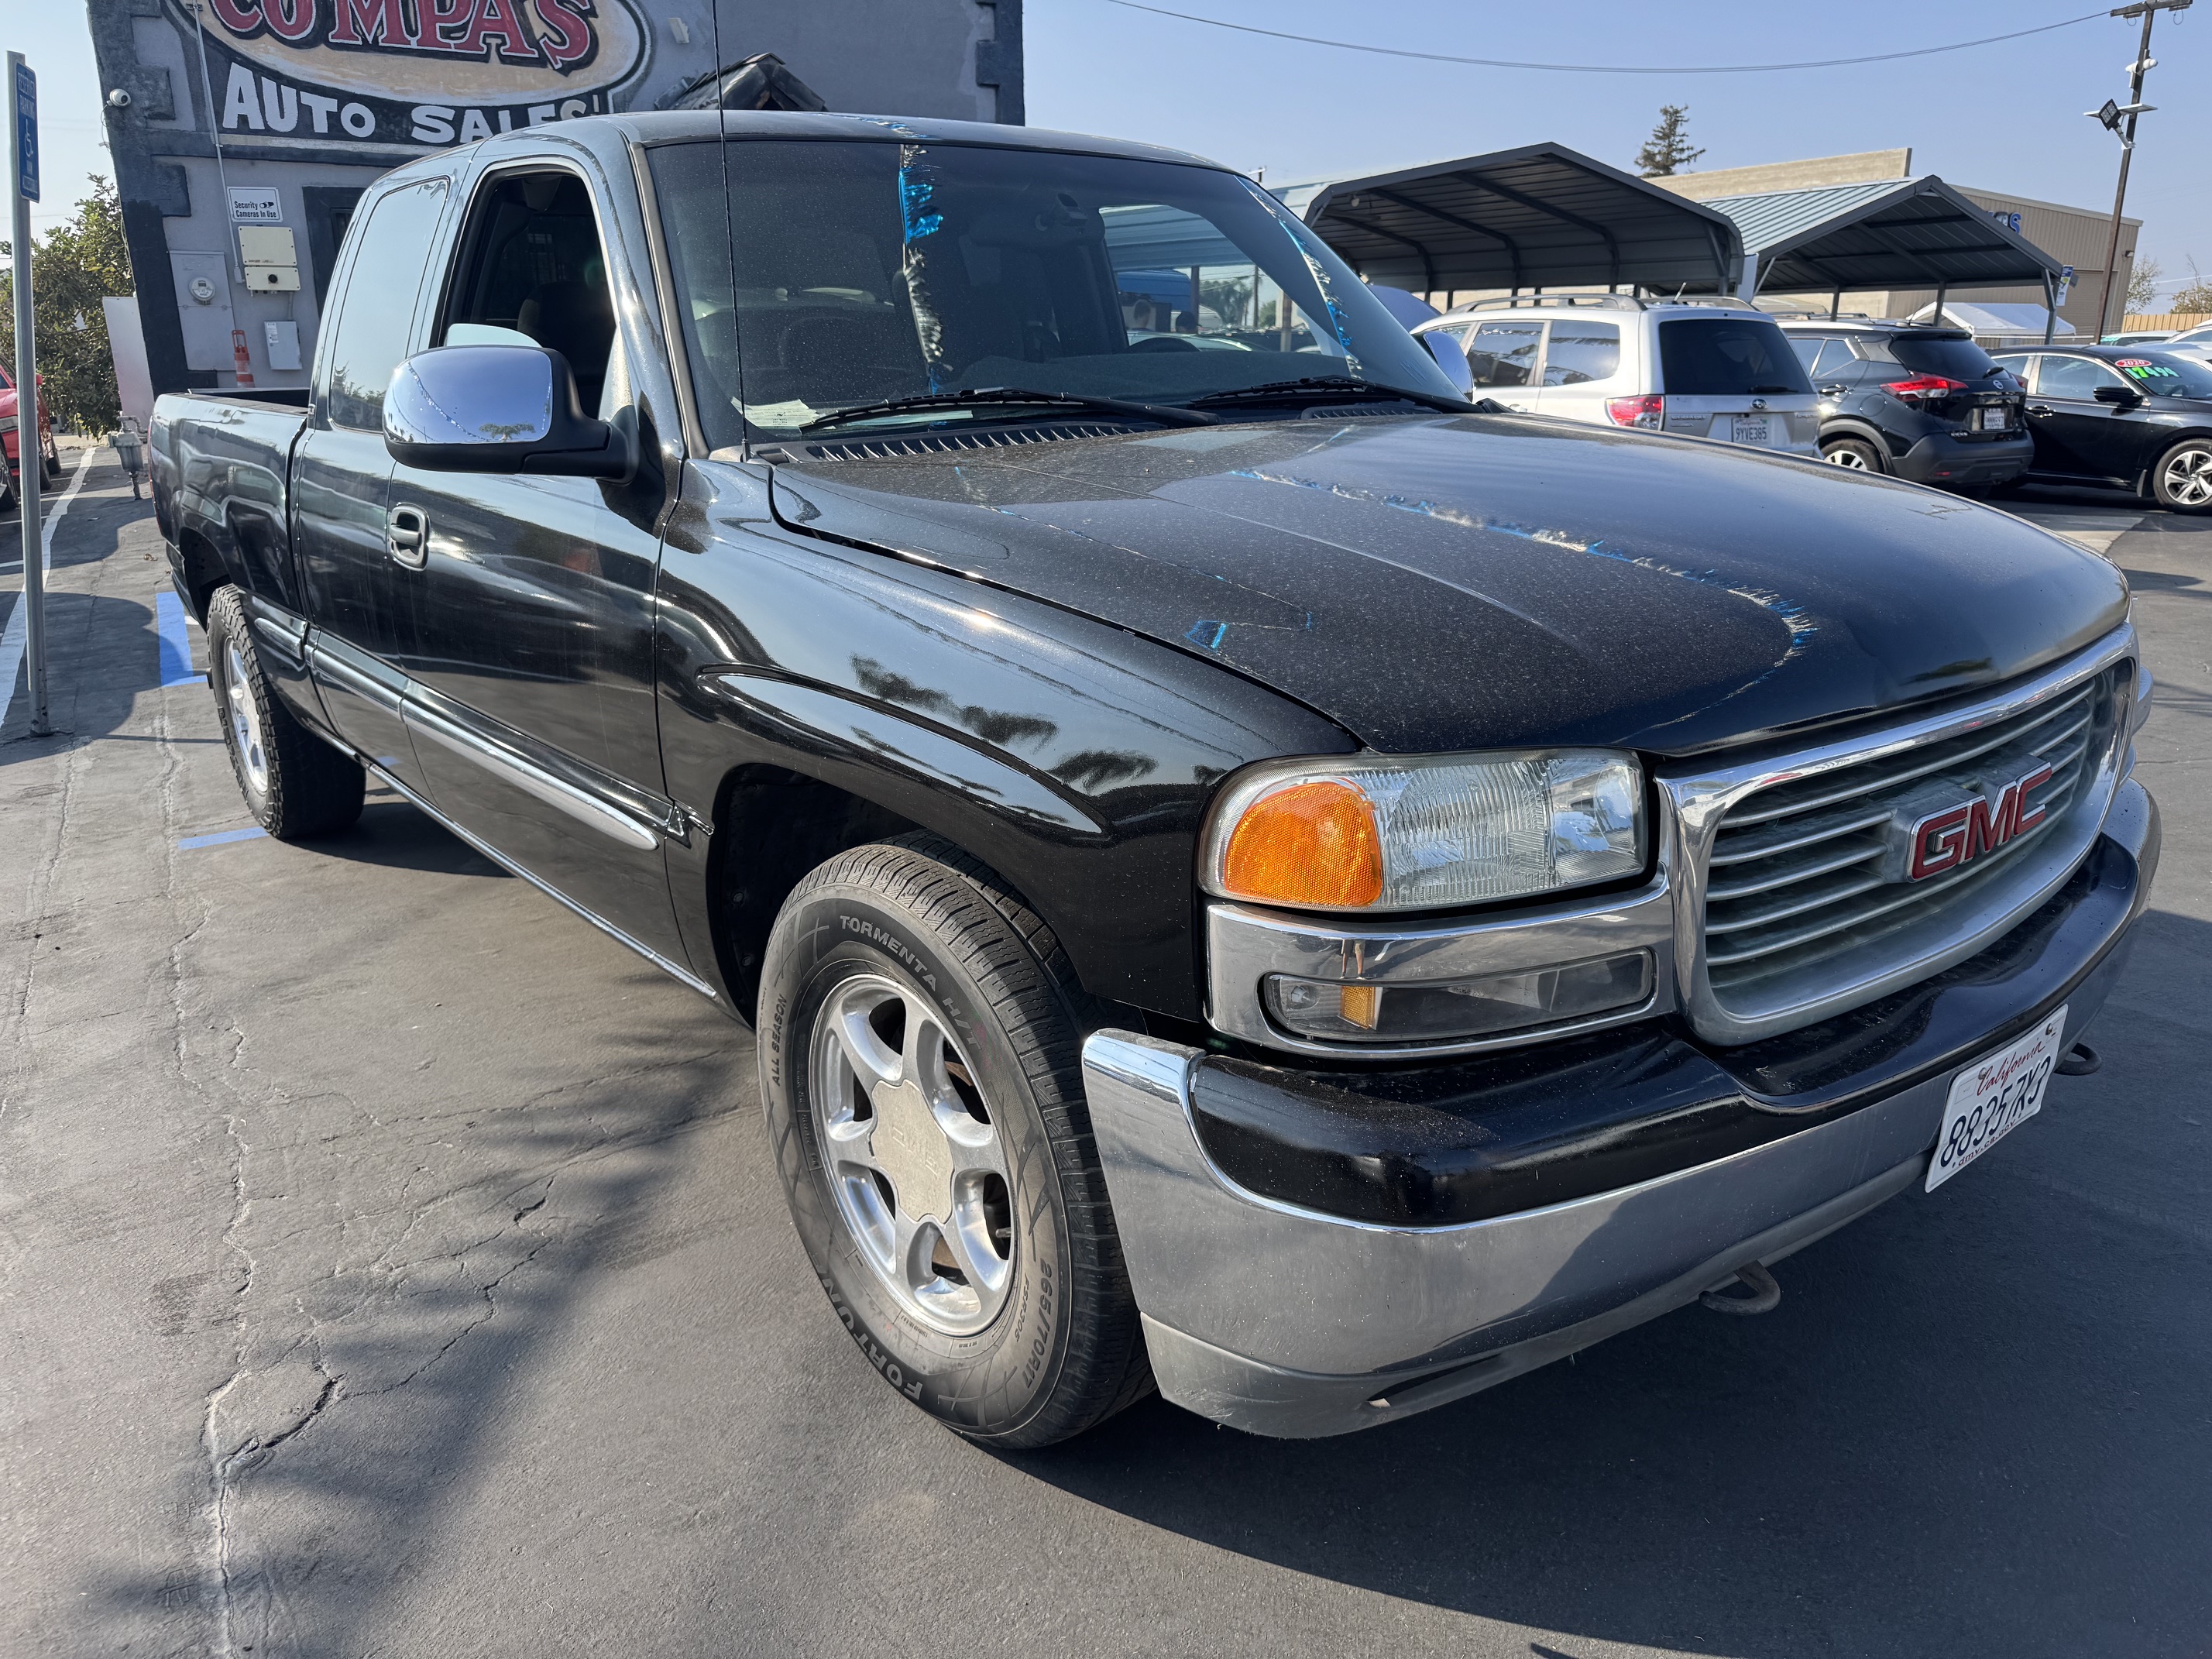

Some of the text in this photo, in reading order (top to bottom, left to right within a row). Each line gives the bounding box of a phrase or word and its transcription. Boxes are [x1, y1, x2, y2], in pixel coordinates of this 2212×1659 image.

[222, 61, 376, 139] AUTO
[234, 201, 258, 211] Security
[235, 209, 259, 218] Cameras
[1735, 426, 1767, 441] 9YVE385
[1907, 762, 2053, 883] GMC
[840, 915, 983, 1050] TORMENTA H/T
[771, 992, 788, 1087] ALL SEASON
[1977, 1038, 2046, 1097] California
[1940, 1055, 2052, 1168] 88357K3
[1958, 1118, 2017, 1166] dmv.ca.gov
[1022, 1257, 1053, 1389] 265/70R17
